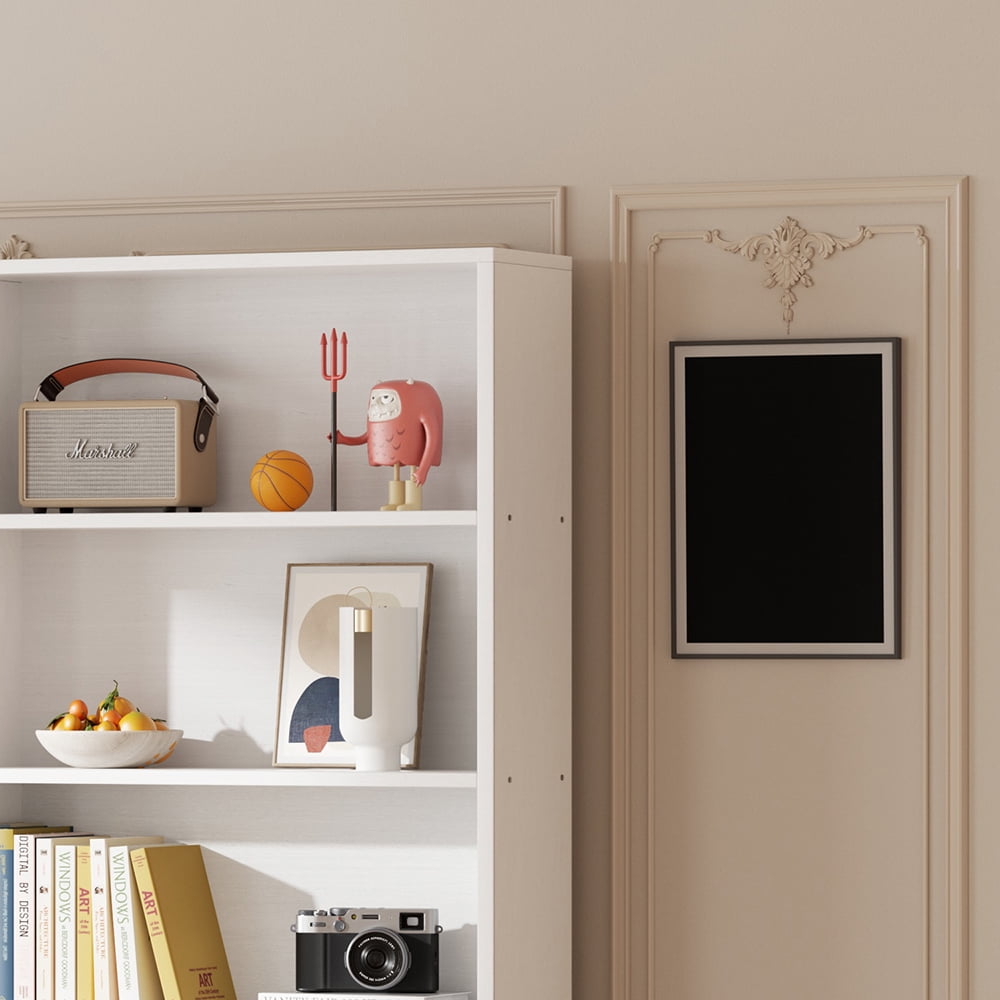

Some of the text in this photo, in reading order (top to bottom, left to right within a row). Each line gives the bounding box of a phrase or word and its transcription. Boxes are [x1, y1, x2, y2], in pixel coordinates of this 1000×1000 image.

[65, 439, 138, 459] Marshall
[19, 836, 29, 938] DIGITAL BY DESIGN
[59, 851, 71, 923] WINDOWS
[79, 887, 90, 915] ART
[142, 890, 158, 917] ART
[98, 907, 106, 960] ARCHITECTURE
[112, 852, 129, 925] WINDOWS
[123, 961, 131, 991] GOODMAN
[198, 972, 214, 988] ART
